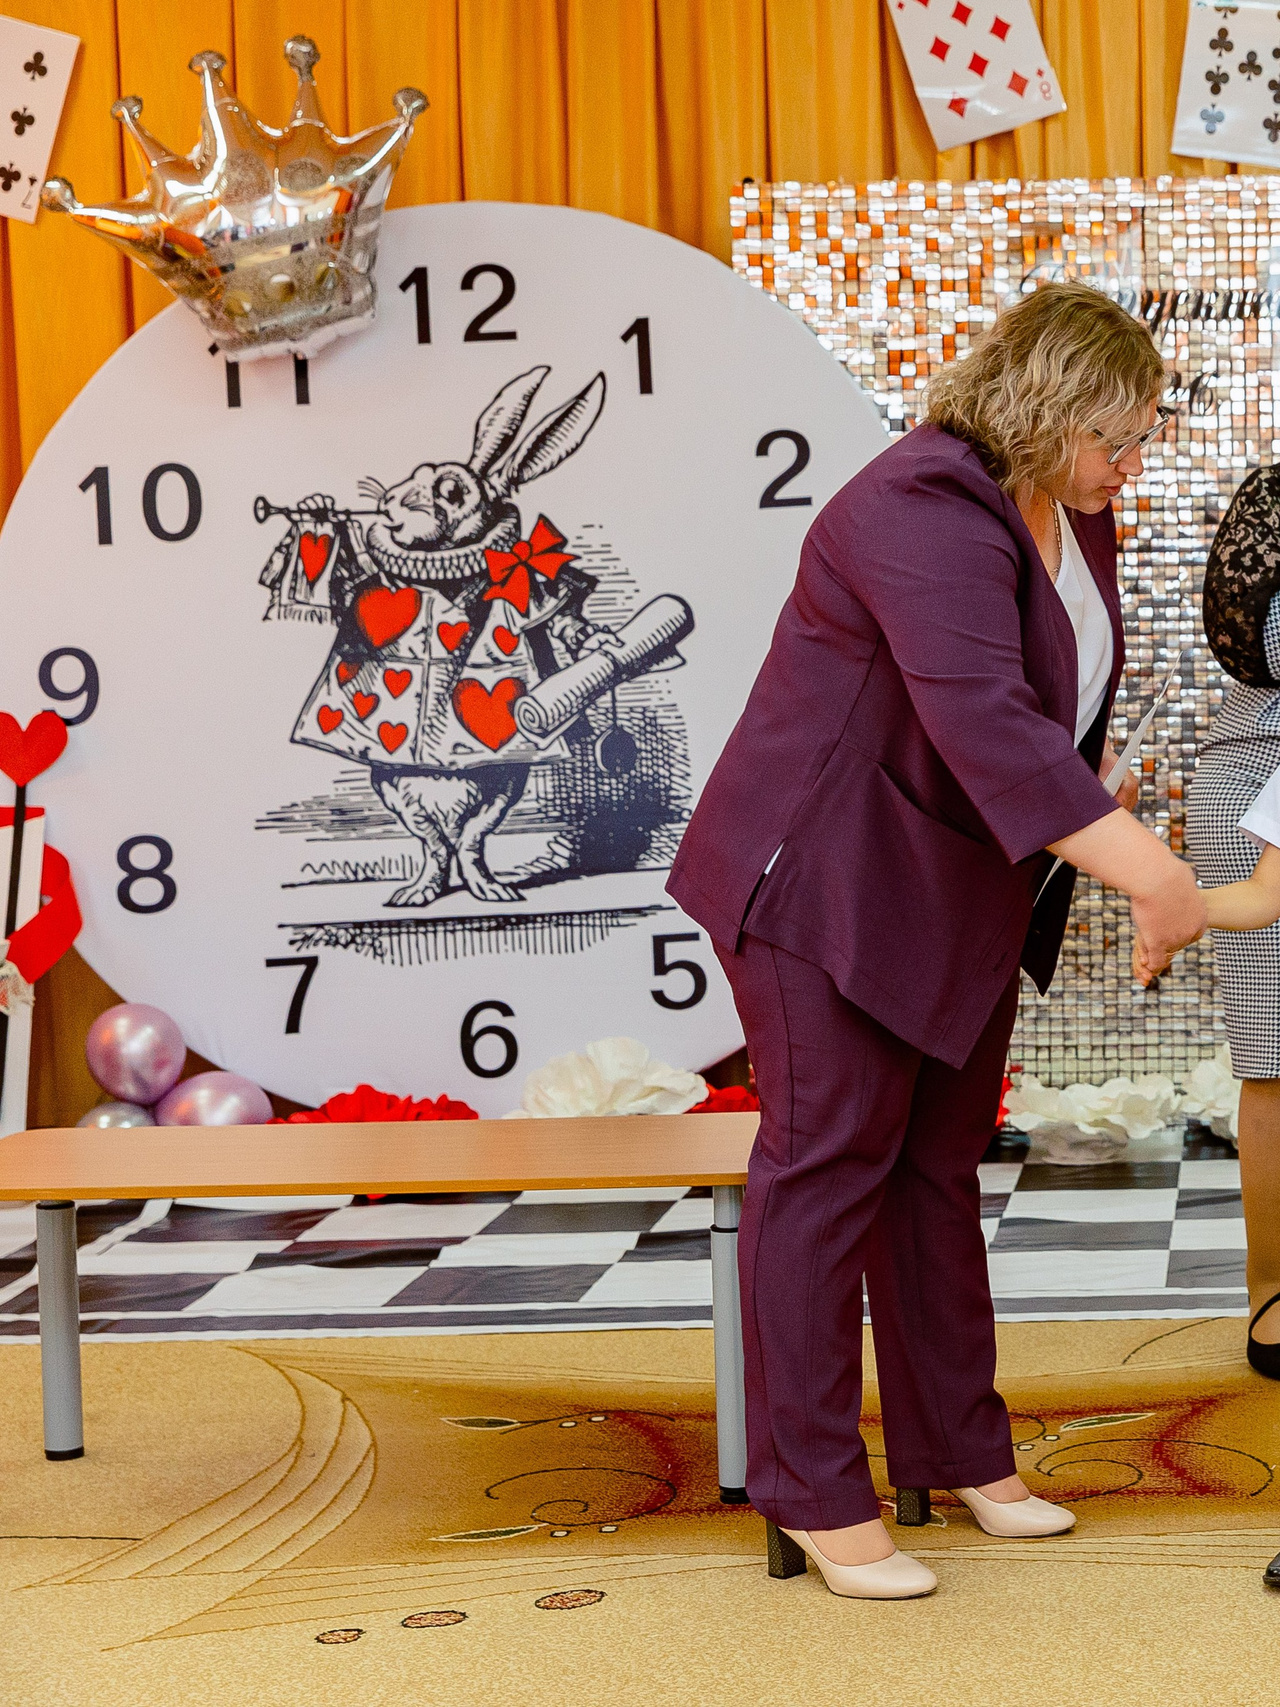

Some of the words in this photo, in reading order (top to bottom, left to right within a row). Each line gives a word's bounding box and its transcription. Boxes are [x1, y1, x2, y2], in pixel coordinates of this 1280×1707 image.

[398, 263, 518, 345] 12
[620, 317, 653, 395] 1
[78, 463, 202, 545] 10
[755, 429, 812, 509] 2
[38, 647, 100, 727] 9
[116, 835, 177, 914] 8
[265, 955, 319, 1035] 7
[650, 932, 707, 1011] 5
[460, 1000, 519, 1079] 6
